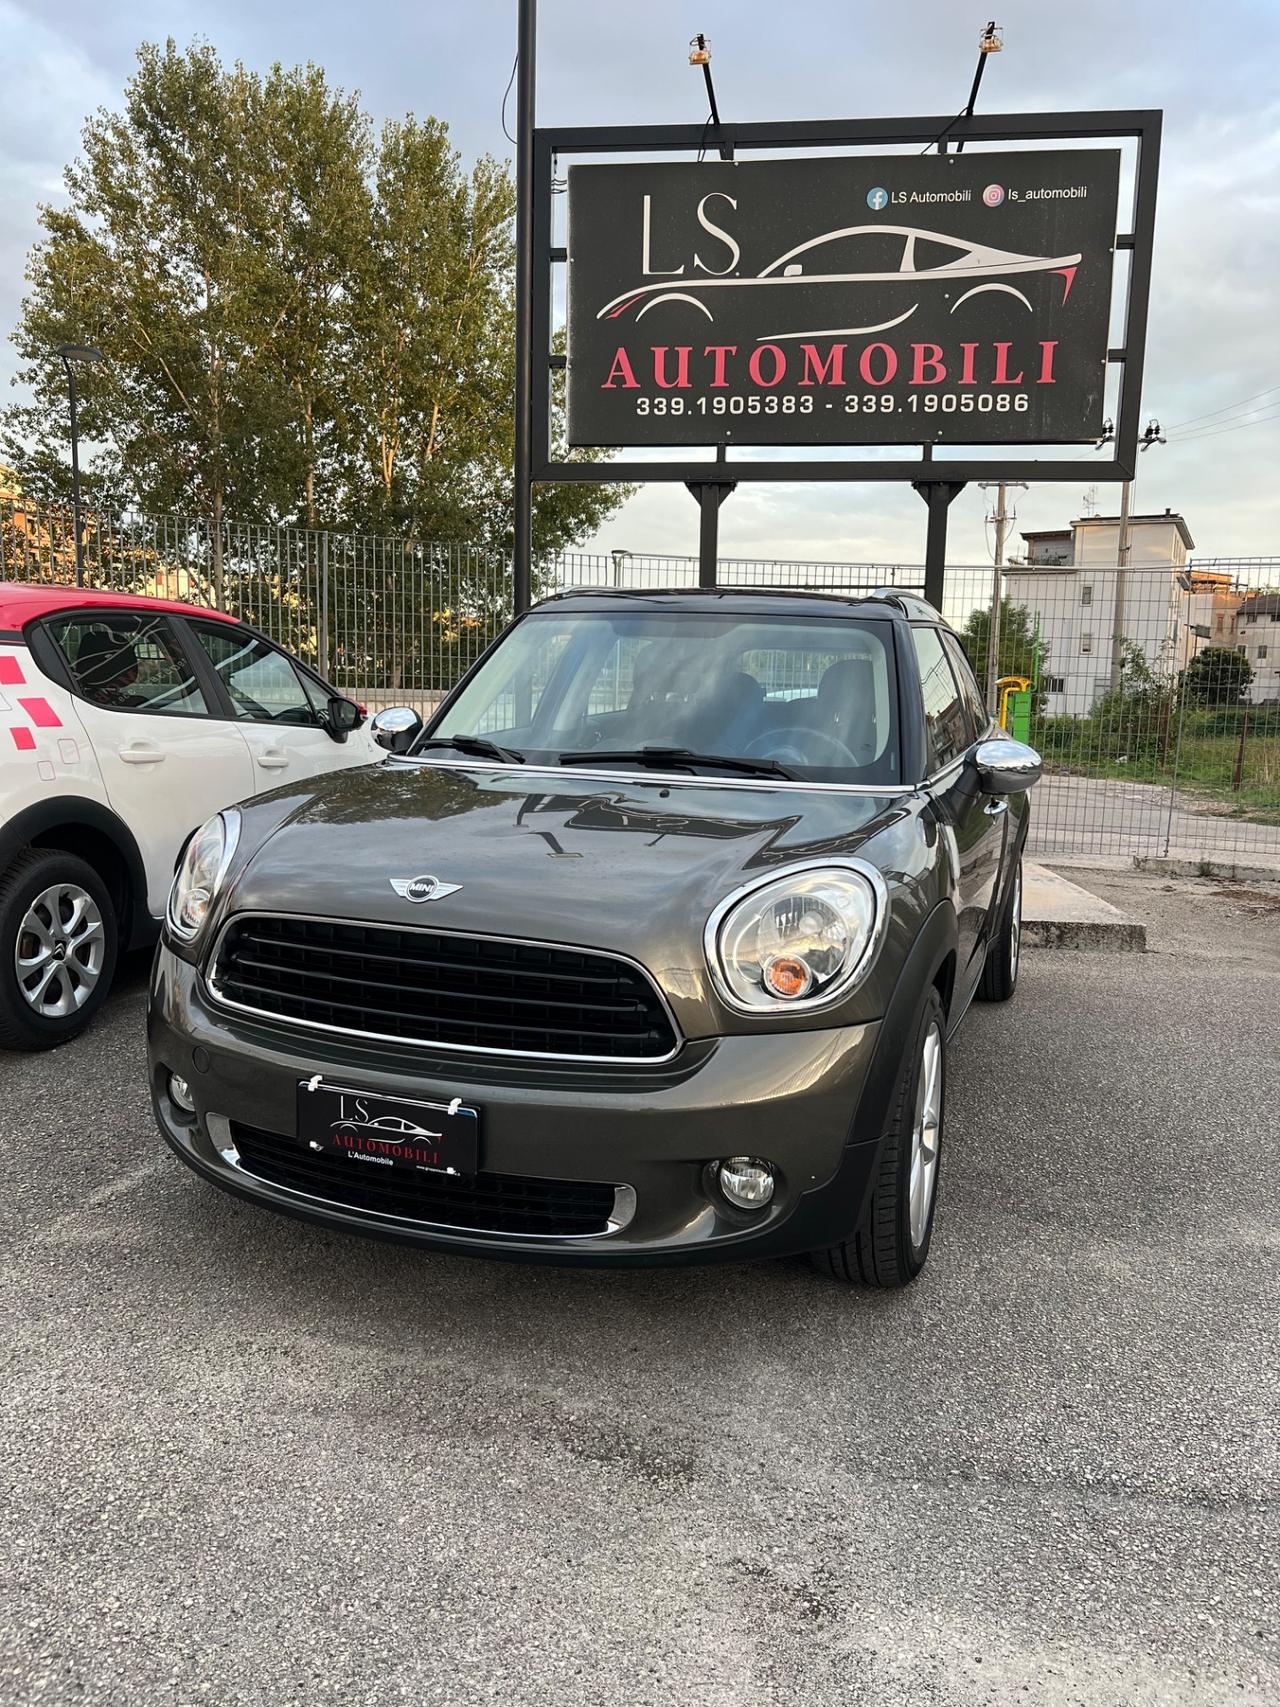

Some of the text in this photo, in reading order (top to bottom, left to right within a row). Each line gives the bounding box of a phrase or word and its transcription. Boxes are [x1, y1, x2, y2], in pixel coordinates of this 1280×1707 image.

[891, 189, 972, 204] LS Automobili
[1008, 185, 1087, 204] ls_automobili
[642, 192, 741, 277] LS
[602, 340, 1059, 389] AUTOMOBILI
[636, 395, 815, 416] 339.1905383
[844, 392, 1029, 413] 339.1905086
[409, 883, 435, 893] MINI
[340, 1095, 370, 1123] LS
[332, 1134, 441, 1164] AUTOMOBILI
[347, 1150, 394, 1166] L'Automobile
